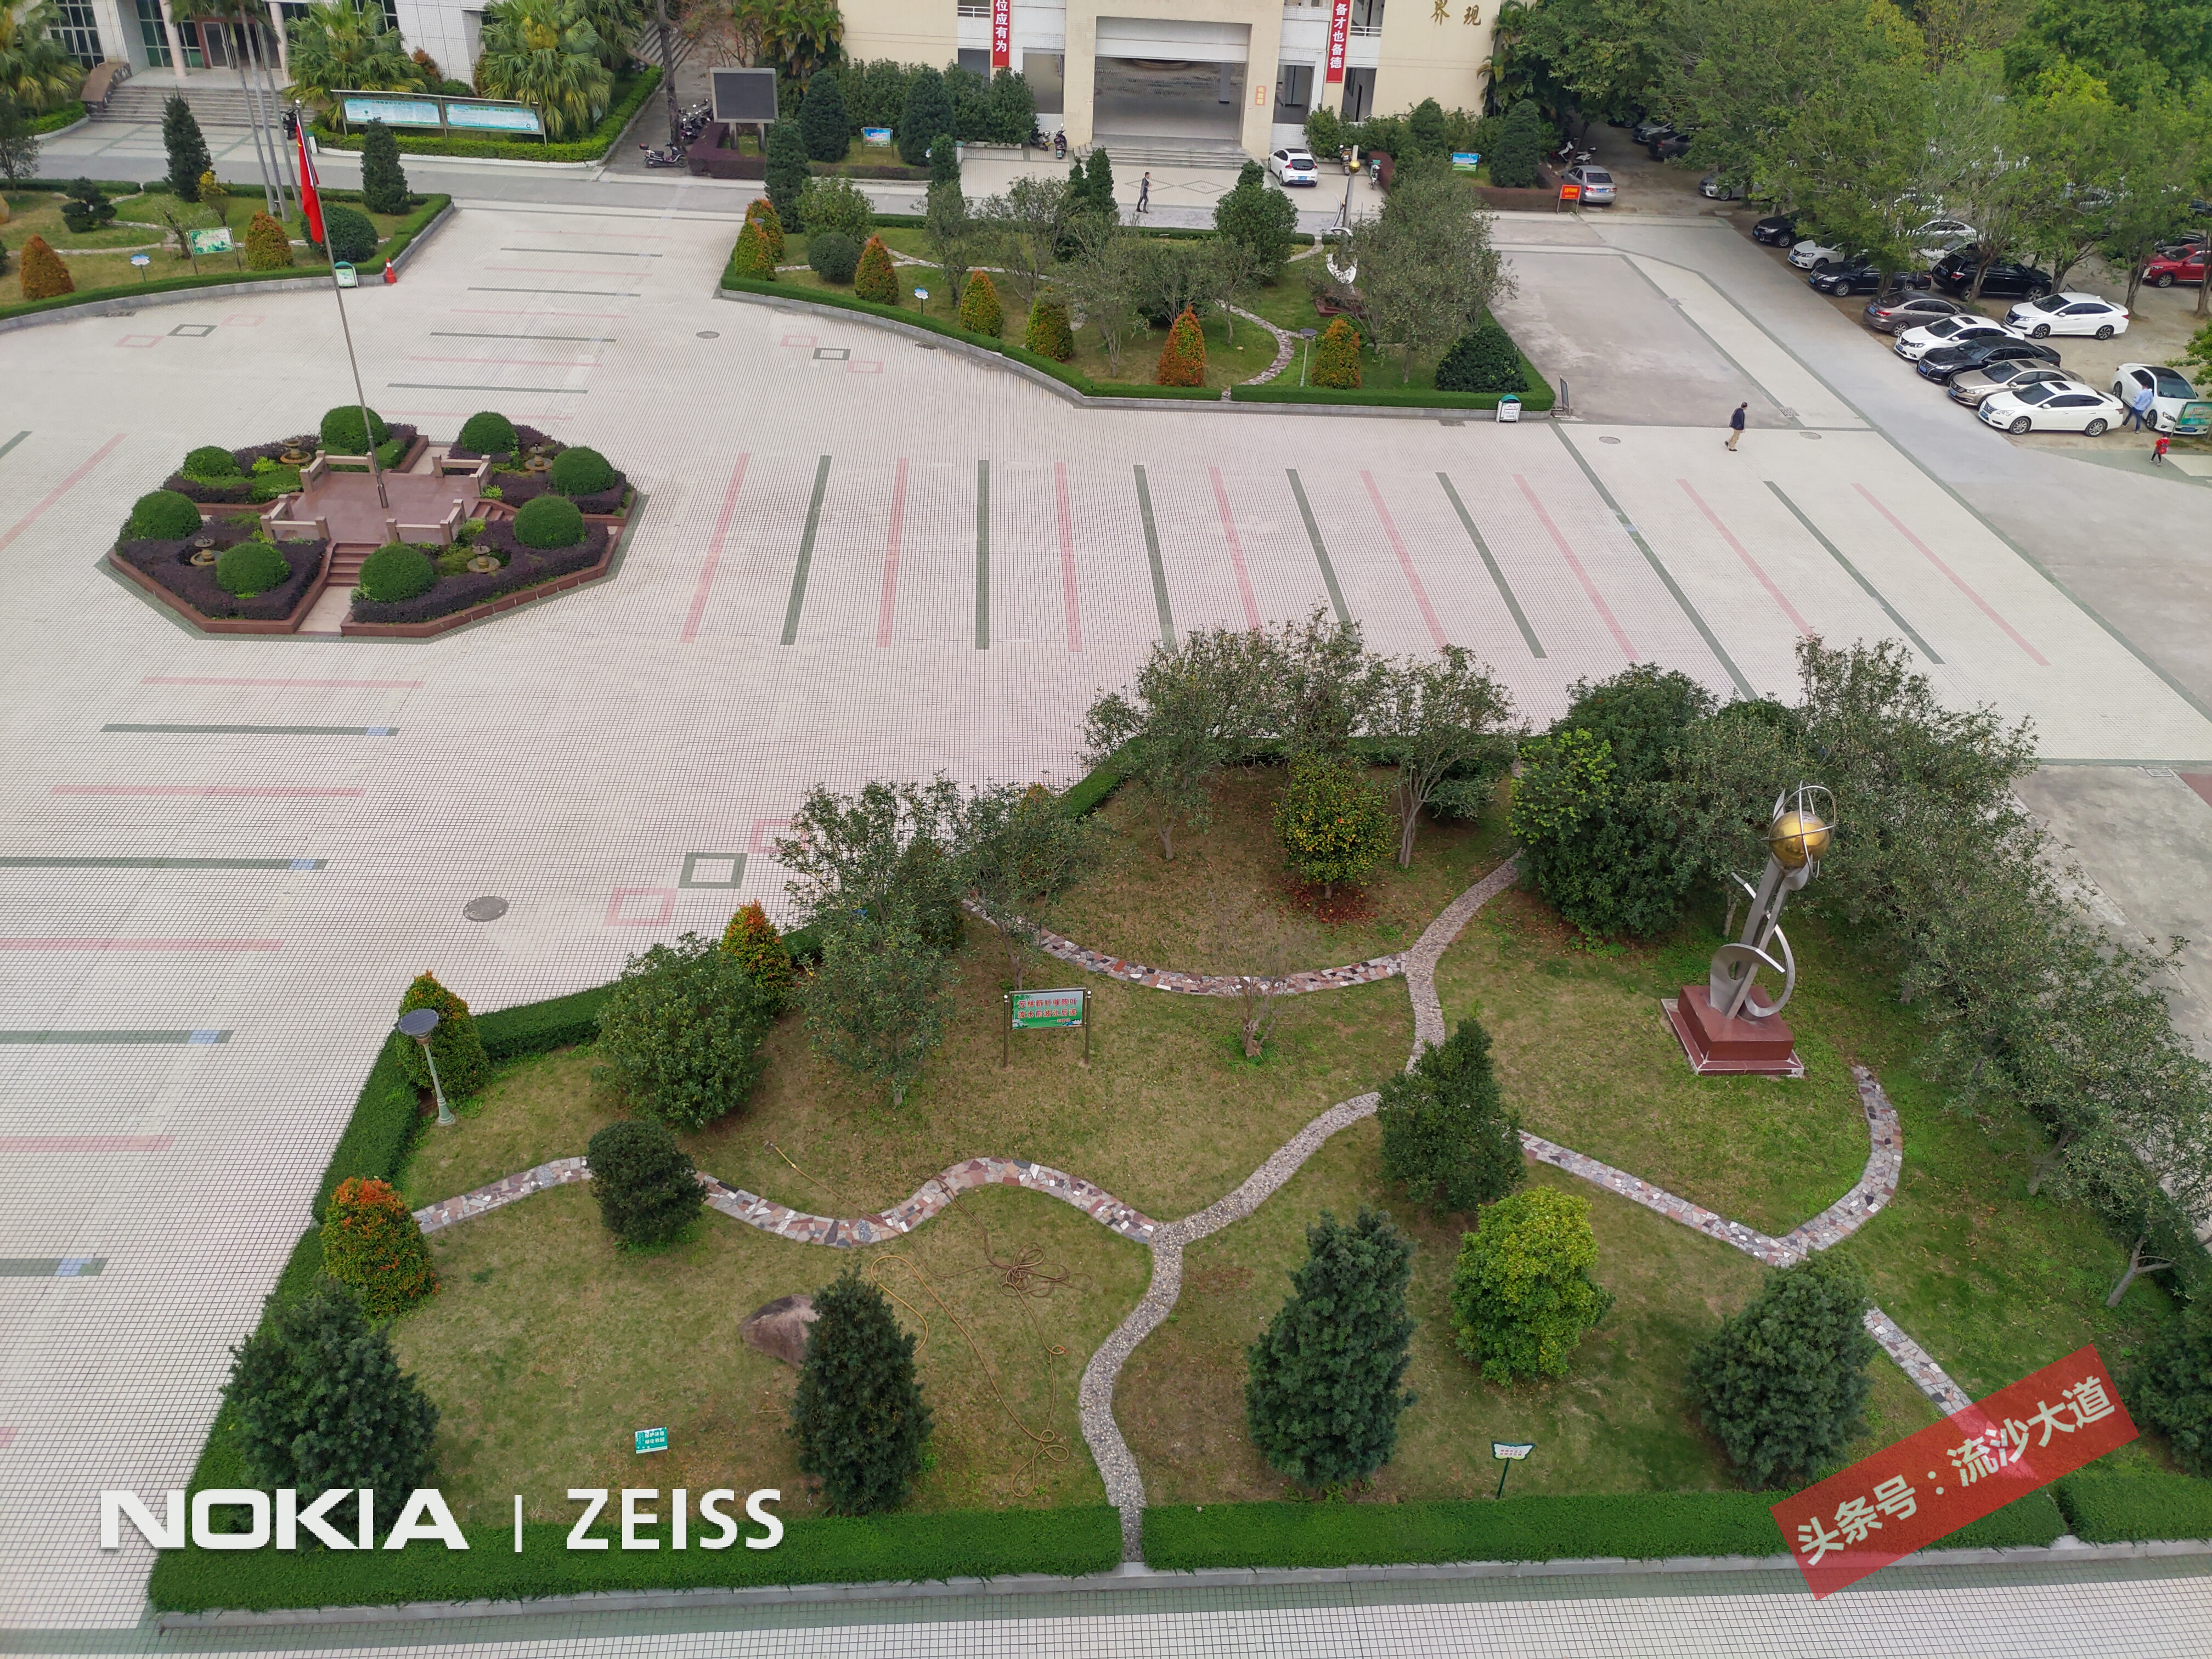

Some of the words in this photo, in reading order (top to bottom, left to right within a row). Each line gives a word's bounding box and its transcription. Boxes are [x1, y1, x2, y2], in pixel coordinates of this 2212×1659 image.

[996, 0, 1008, 52] 位应有为
[1330, 3, 1348, 69] 备才也备德
[1018, 998, 1077, 1008] 芳林新叶催陈叶
[1018, 1008, 1077, 1018] 流水前波让后波
